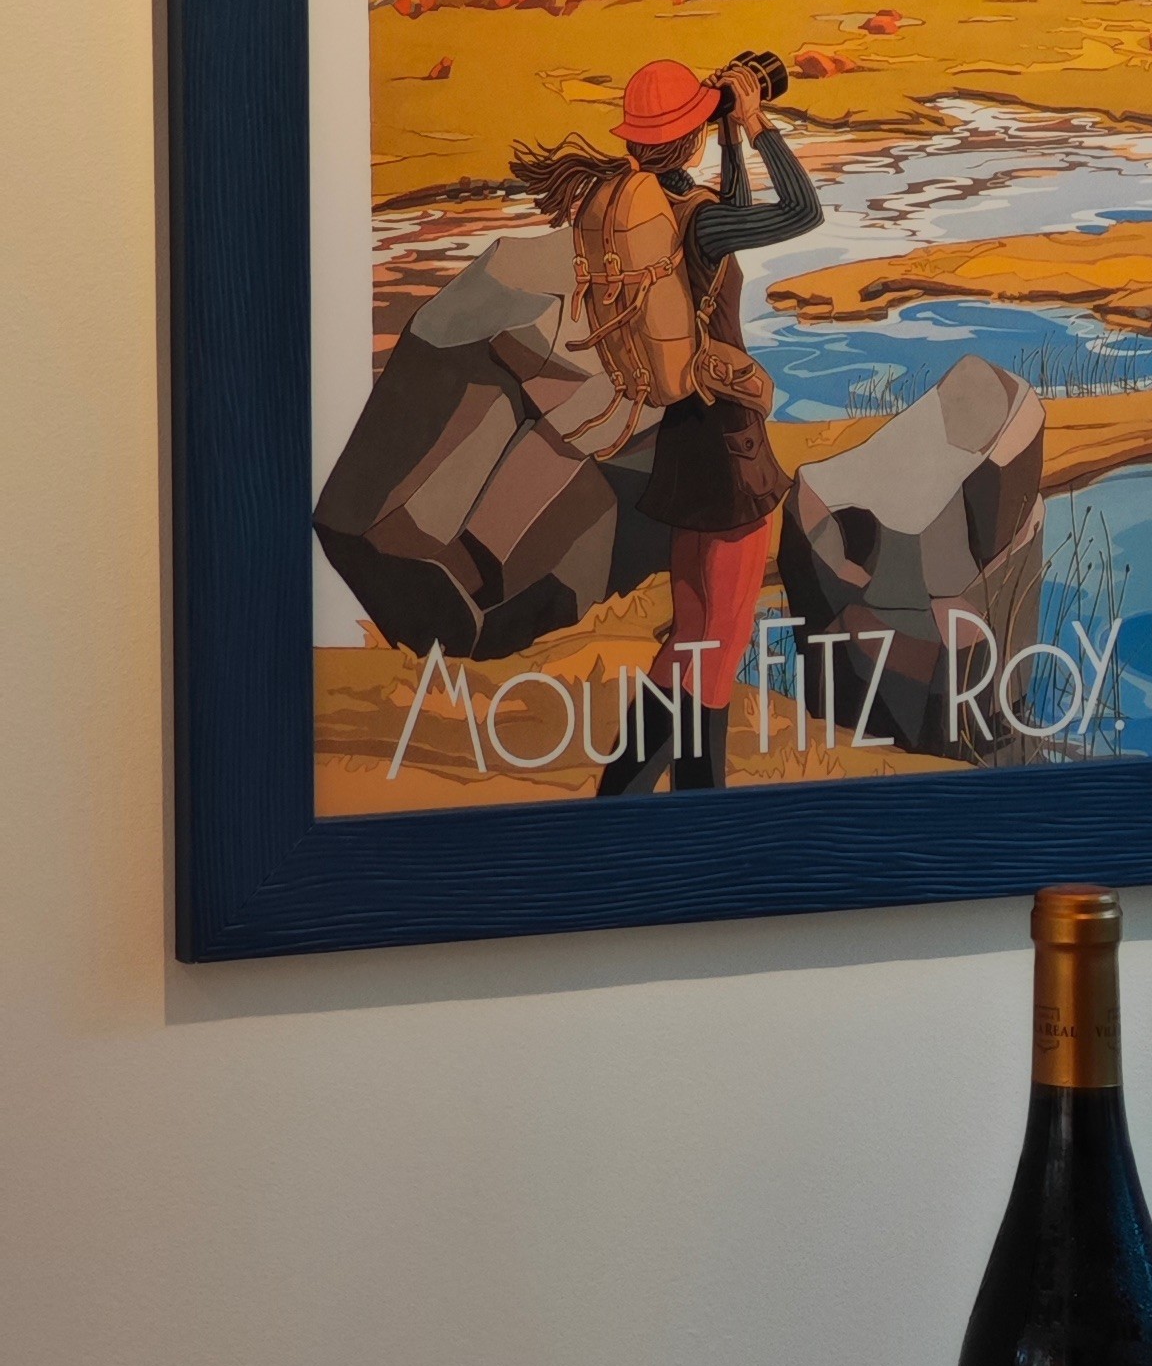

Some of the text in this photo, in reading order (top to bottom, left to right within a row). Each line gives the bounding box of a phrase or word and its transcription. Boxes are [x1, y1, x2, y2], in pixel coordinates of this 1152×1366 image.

[386, 638, 722, 780] MOUNT
[758, 616, 897, 754] FITZ
[947, 608, 1126, 743] ROY.
